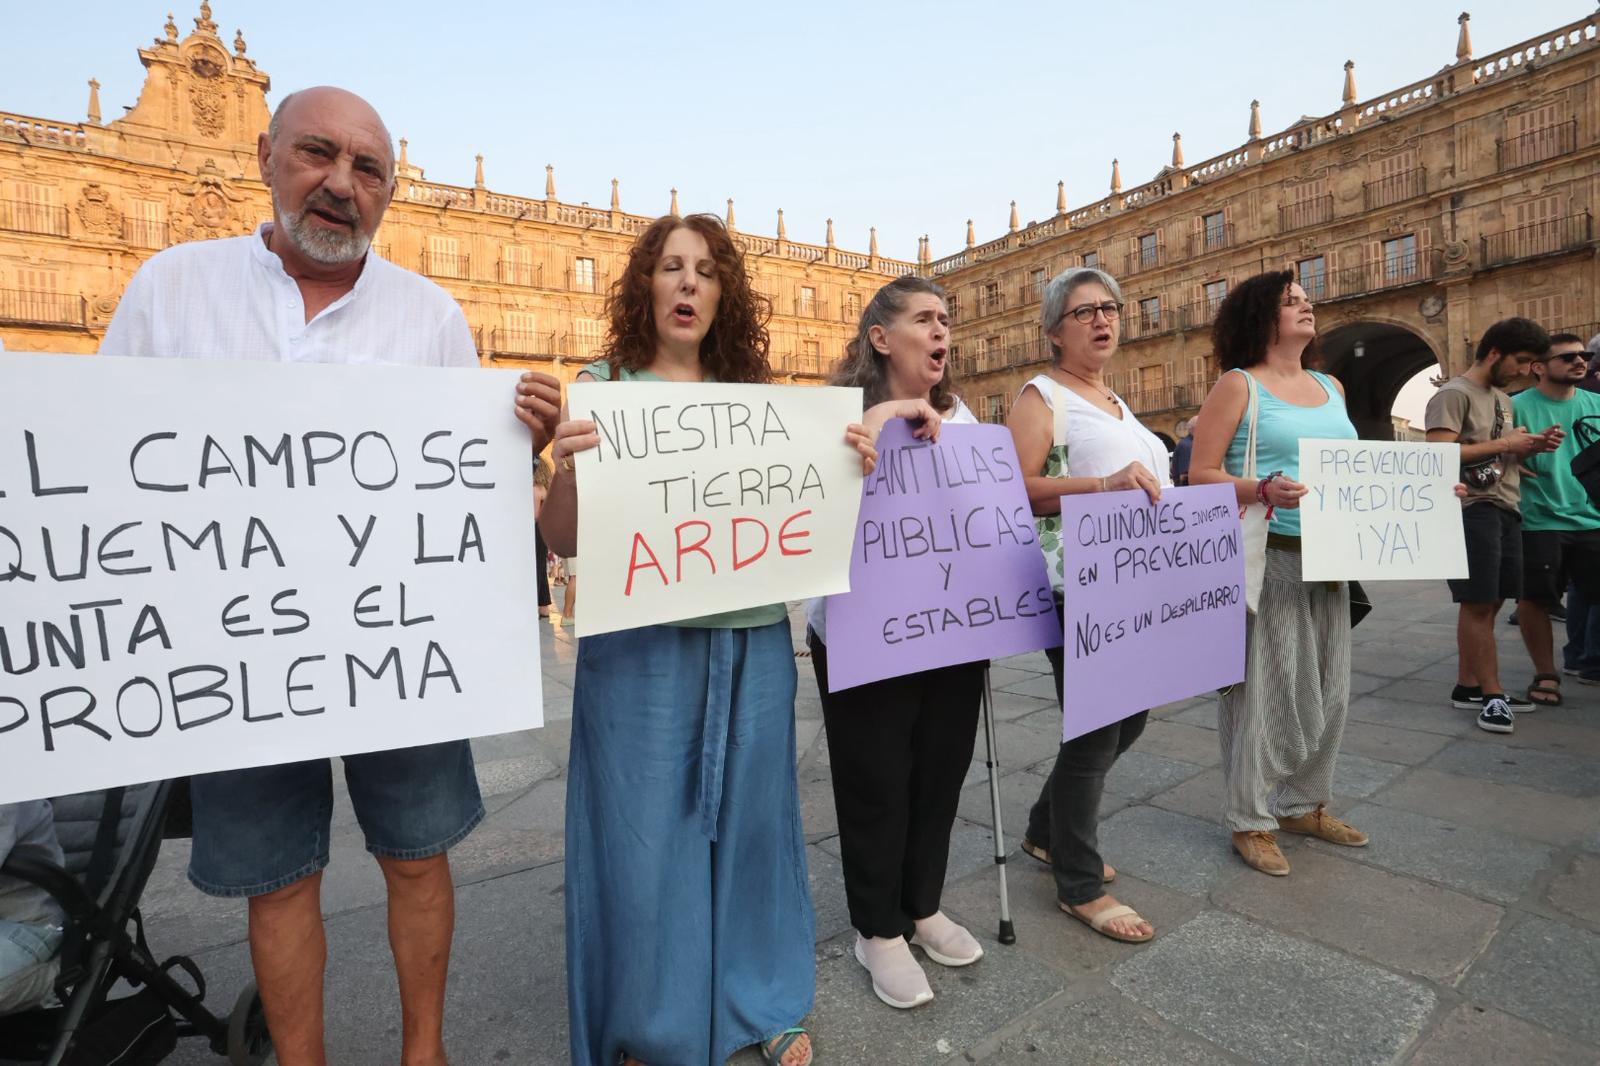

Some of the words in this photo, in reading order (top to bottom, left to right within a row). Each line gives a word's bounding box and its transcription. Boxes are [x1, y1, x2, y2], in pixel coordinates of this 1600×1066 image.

[591, 401, 790, 462] NUESTRA
[0, 429, 88, 497] L
[130, 431, 398, 491] CAMPO
[415, 431, 495, 490] SE
[1314, 484, 1325, 511] Y
[1338, 482, 1434, 512] MEDIOS
[0, 516, 285, 582] QUEMA
[337, 514, 376, 567] Y
[414, 512, 486, 564] LA
[624, 510, 812, 596] ARDE
[1078, 563, 1098, 586] EN
[939, 562, 951, 590] Y
[222, 589, 310, 637] ES
[354, 582, 435, 629] EL
[883, 587, 1053, 644] ESTABLES
[1134, 610, 1152, 633] UN
[0, 640, 462, 752] PROBLEMA
